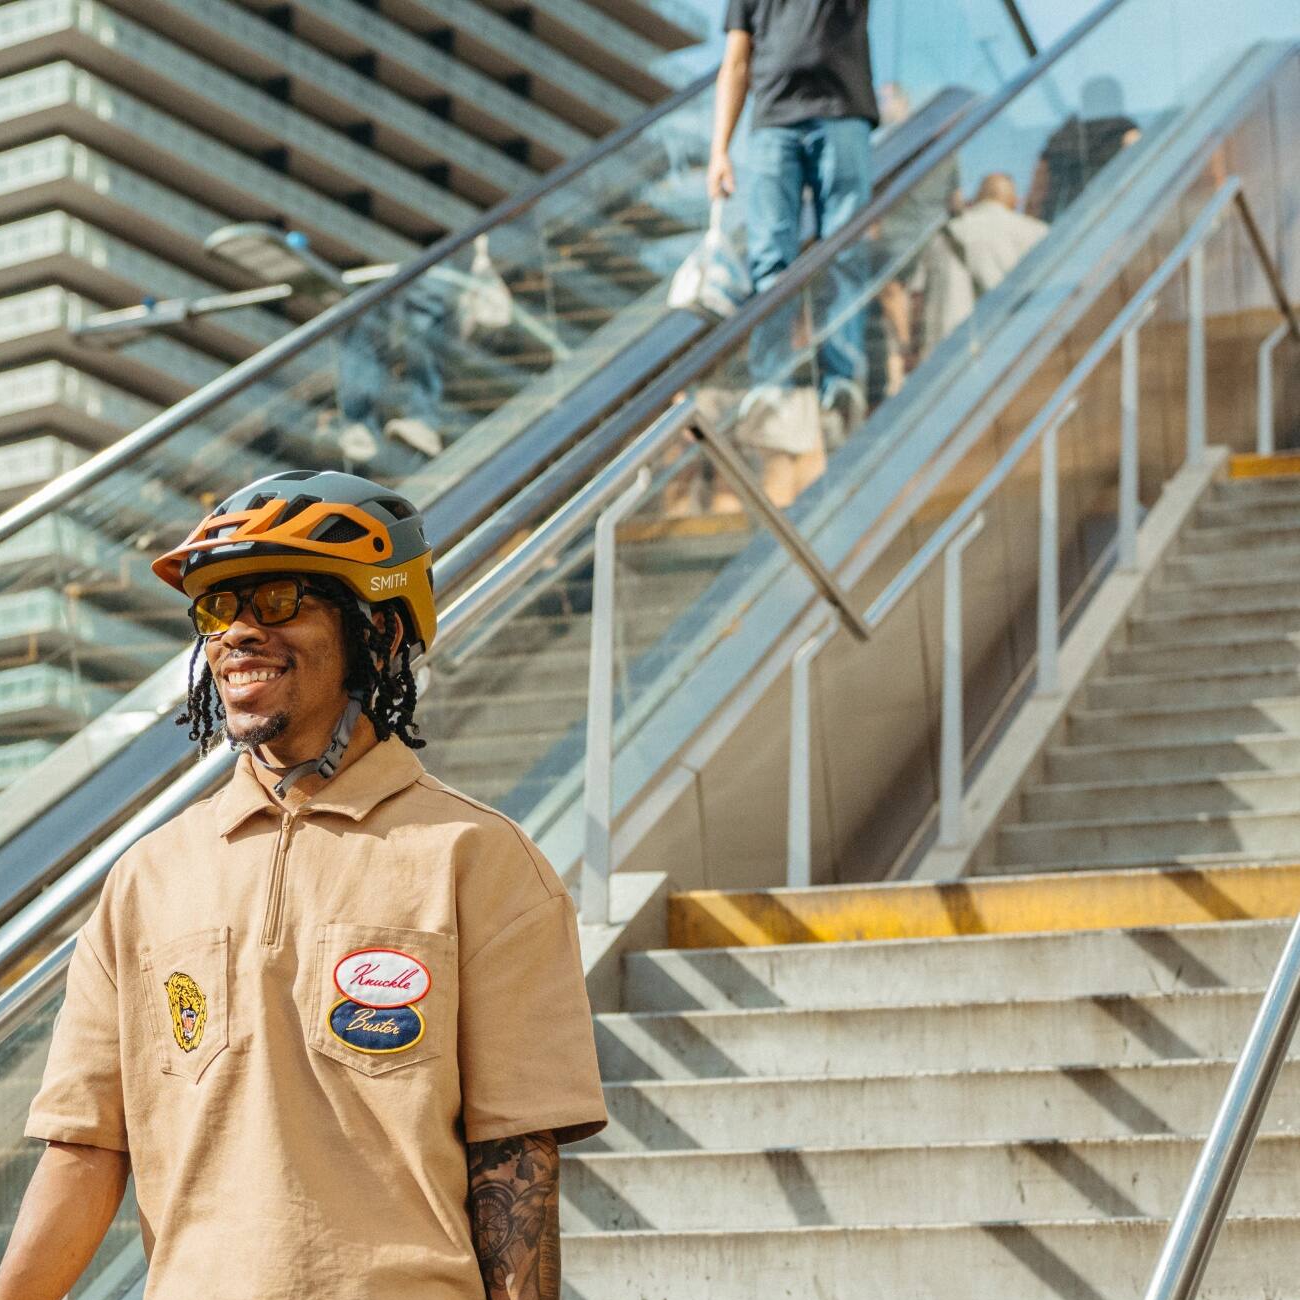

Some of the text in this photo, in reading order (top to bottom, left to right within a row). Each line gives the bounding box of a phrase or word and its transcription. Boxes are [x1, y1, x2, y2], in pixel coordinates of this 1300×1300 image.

[370, 571, 408, 591] SMITH
[350, 963, 420, 990] Knuckle
[346, 1008, 401, 1035] Buster
